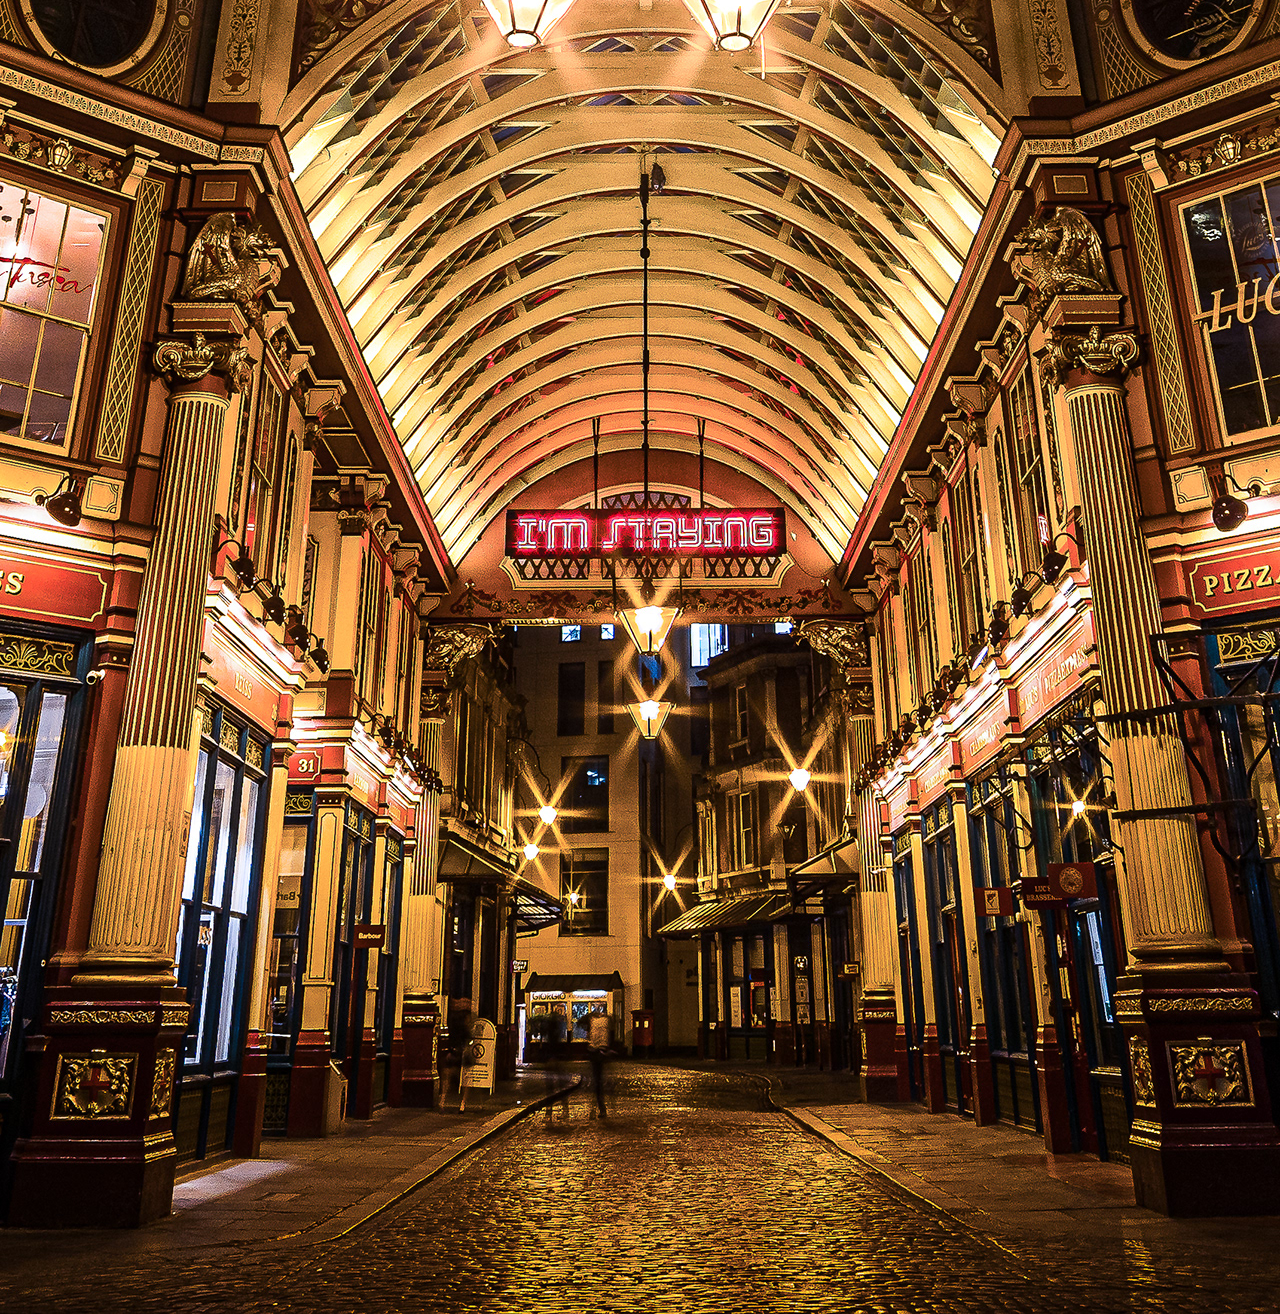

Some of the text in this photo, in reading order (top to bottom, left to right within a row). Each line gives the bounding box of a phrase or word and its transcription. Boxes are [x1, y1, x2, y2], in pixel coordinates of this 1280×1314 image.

[518, 516, 774, 550] I'M STAYING
[297, 758, 315, 773] 31
[358, 931, 382, 941] Barbour
